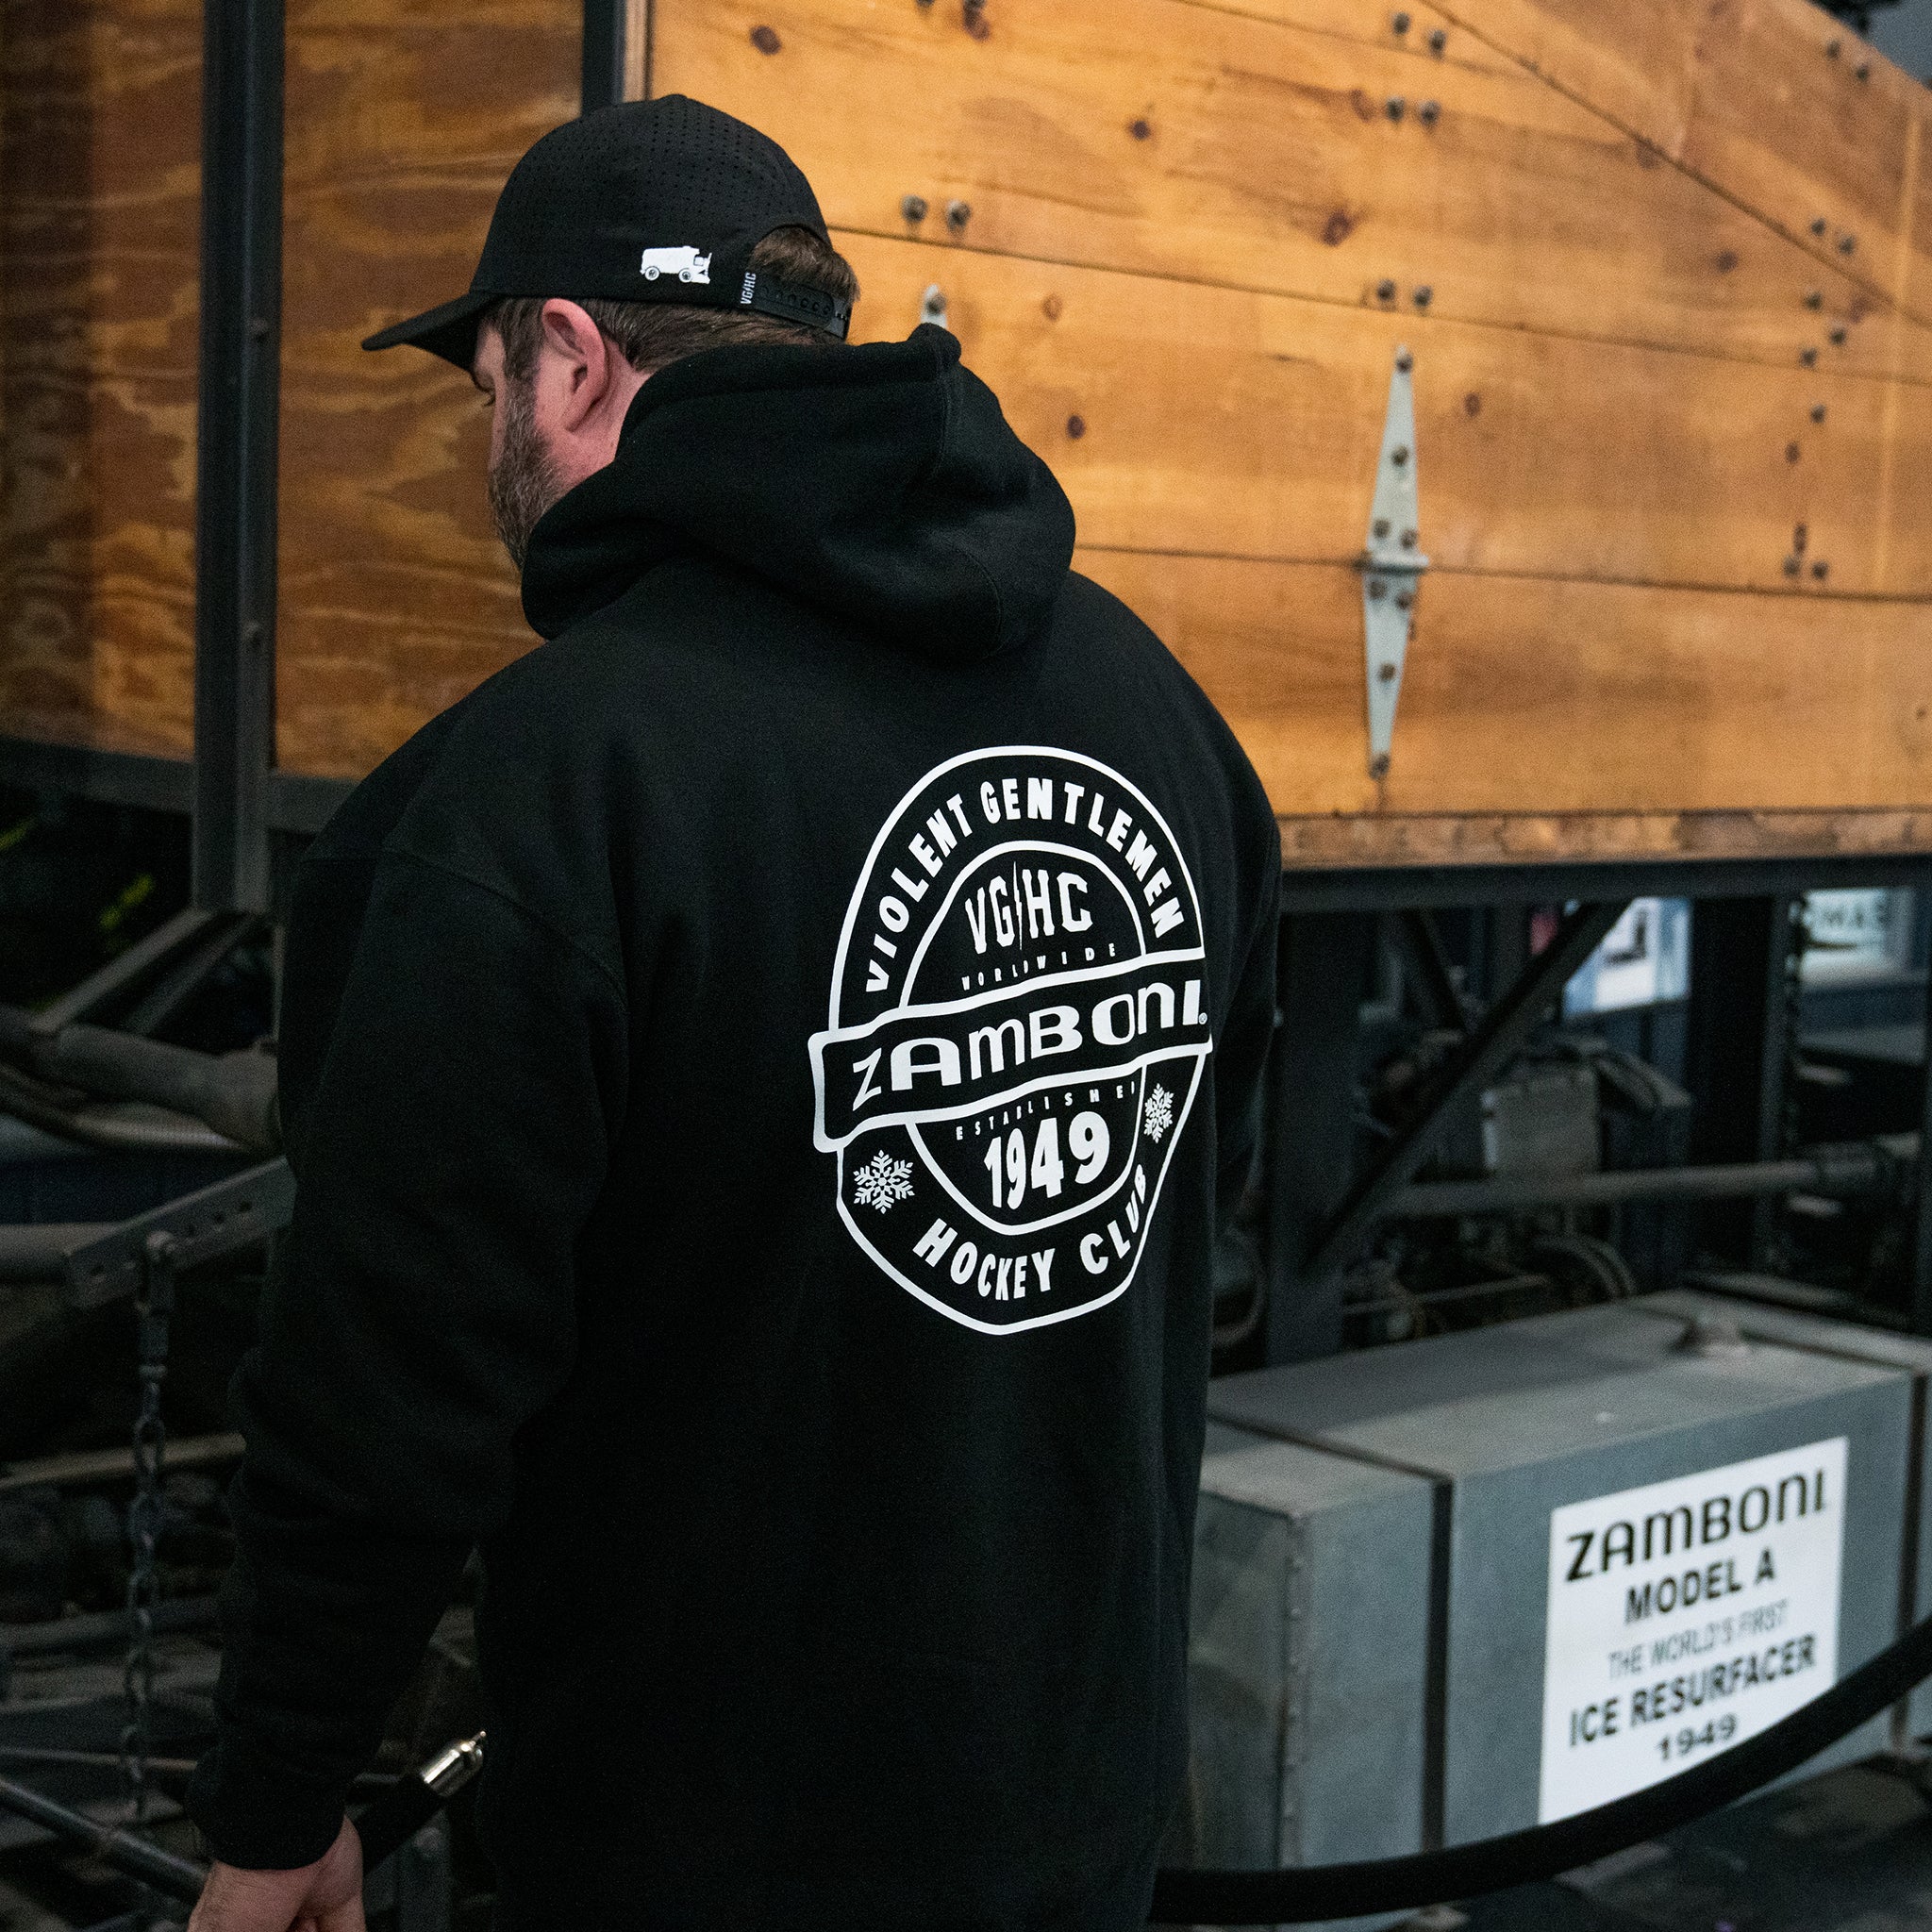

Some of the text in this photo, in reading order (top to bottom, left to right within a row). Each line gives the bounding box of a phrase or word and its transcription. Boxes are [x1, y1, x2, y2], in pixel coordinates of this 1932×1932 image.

[865, 777, 1185, 992] VIOLENT GENTLEMEN
[961, 942, 1116, 991] WORLDWIDE
[983, 1111, 1110, 1209] 1949
[912, 1164, 1146, 1301] HOCKEY CLUB
[1565, 1468, 1828, 1582] ZAMBONI
[1624, 1547, 1776, 1624] MODEL A
[1607, 1600, 1790, 1680] THE WORLD'S FIRST
[1570, 1634, 1817, 1747] ICE RESURFACER
[1657, 1713, 1739, 1762] 1949
